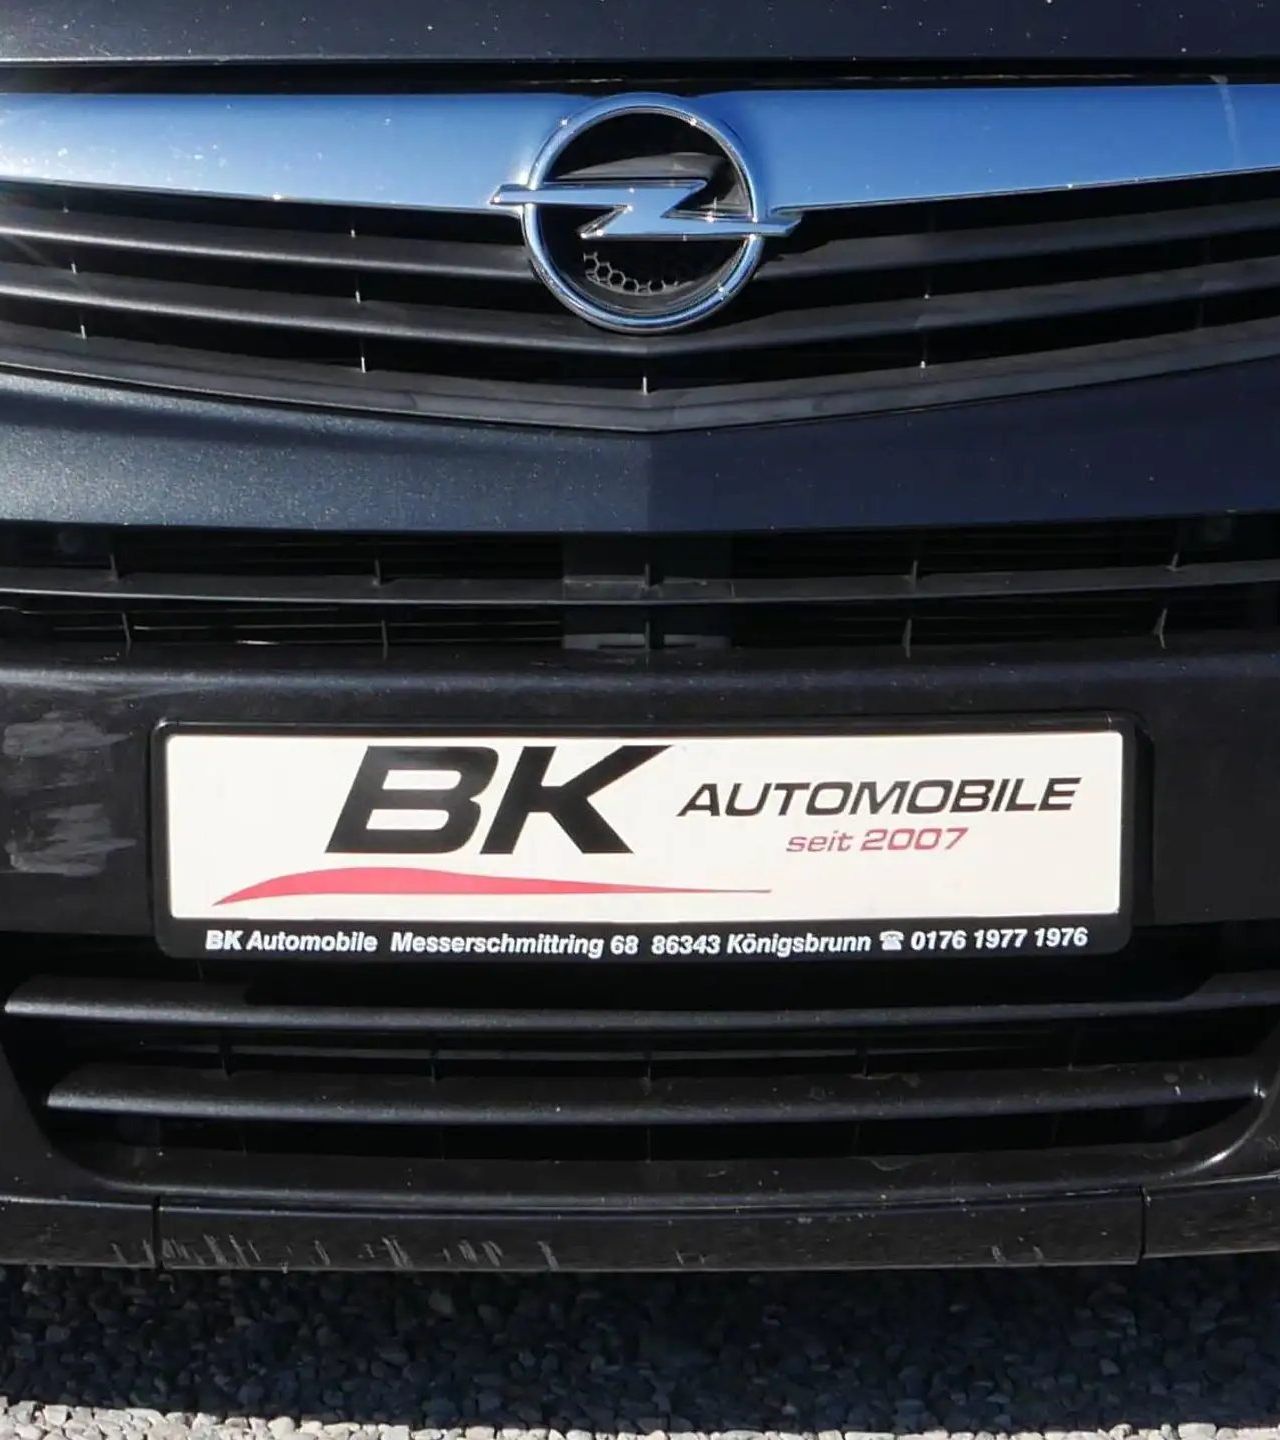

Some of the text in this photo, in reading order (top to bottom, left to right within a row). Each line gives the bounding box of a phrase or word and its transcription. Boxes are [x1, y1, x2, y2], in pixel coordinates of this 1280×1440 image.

[324, 745, 674, 855] BK
[676, 777, 1082, 818] AUTOMOBILE
[785, 826, 969, 854] seit 2007
[205, 926, 1089, 958] BK Automobile Messerschmittring 68 86343 Königsbrunn 0176 1977 1976
